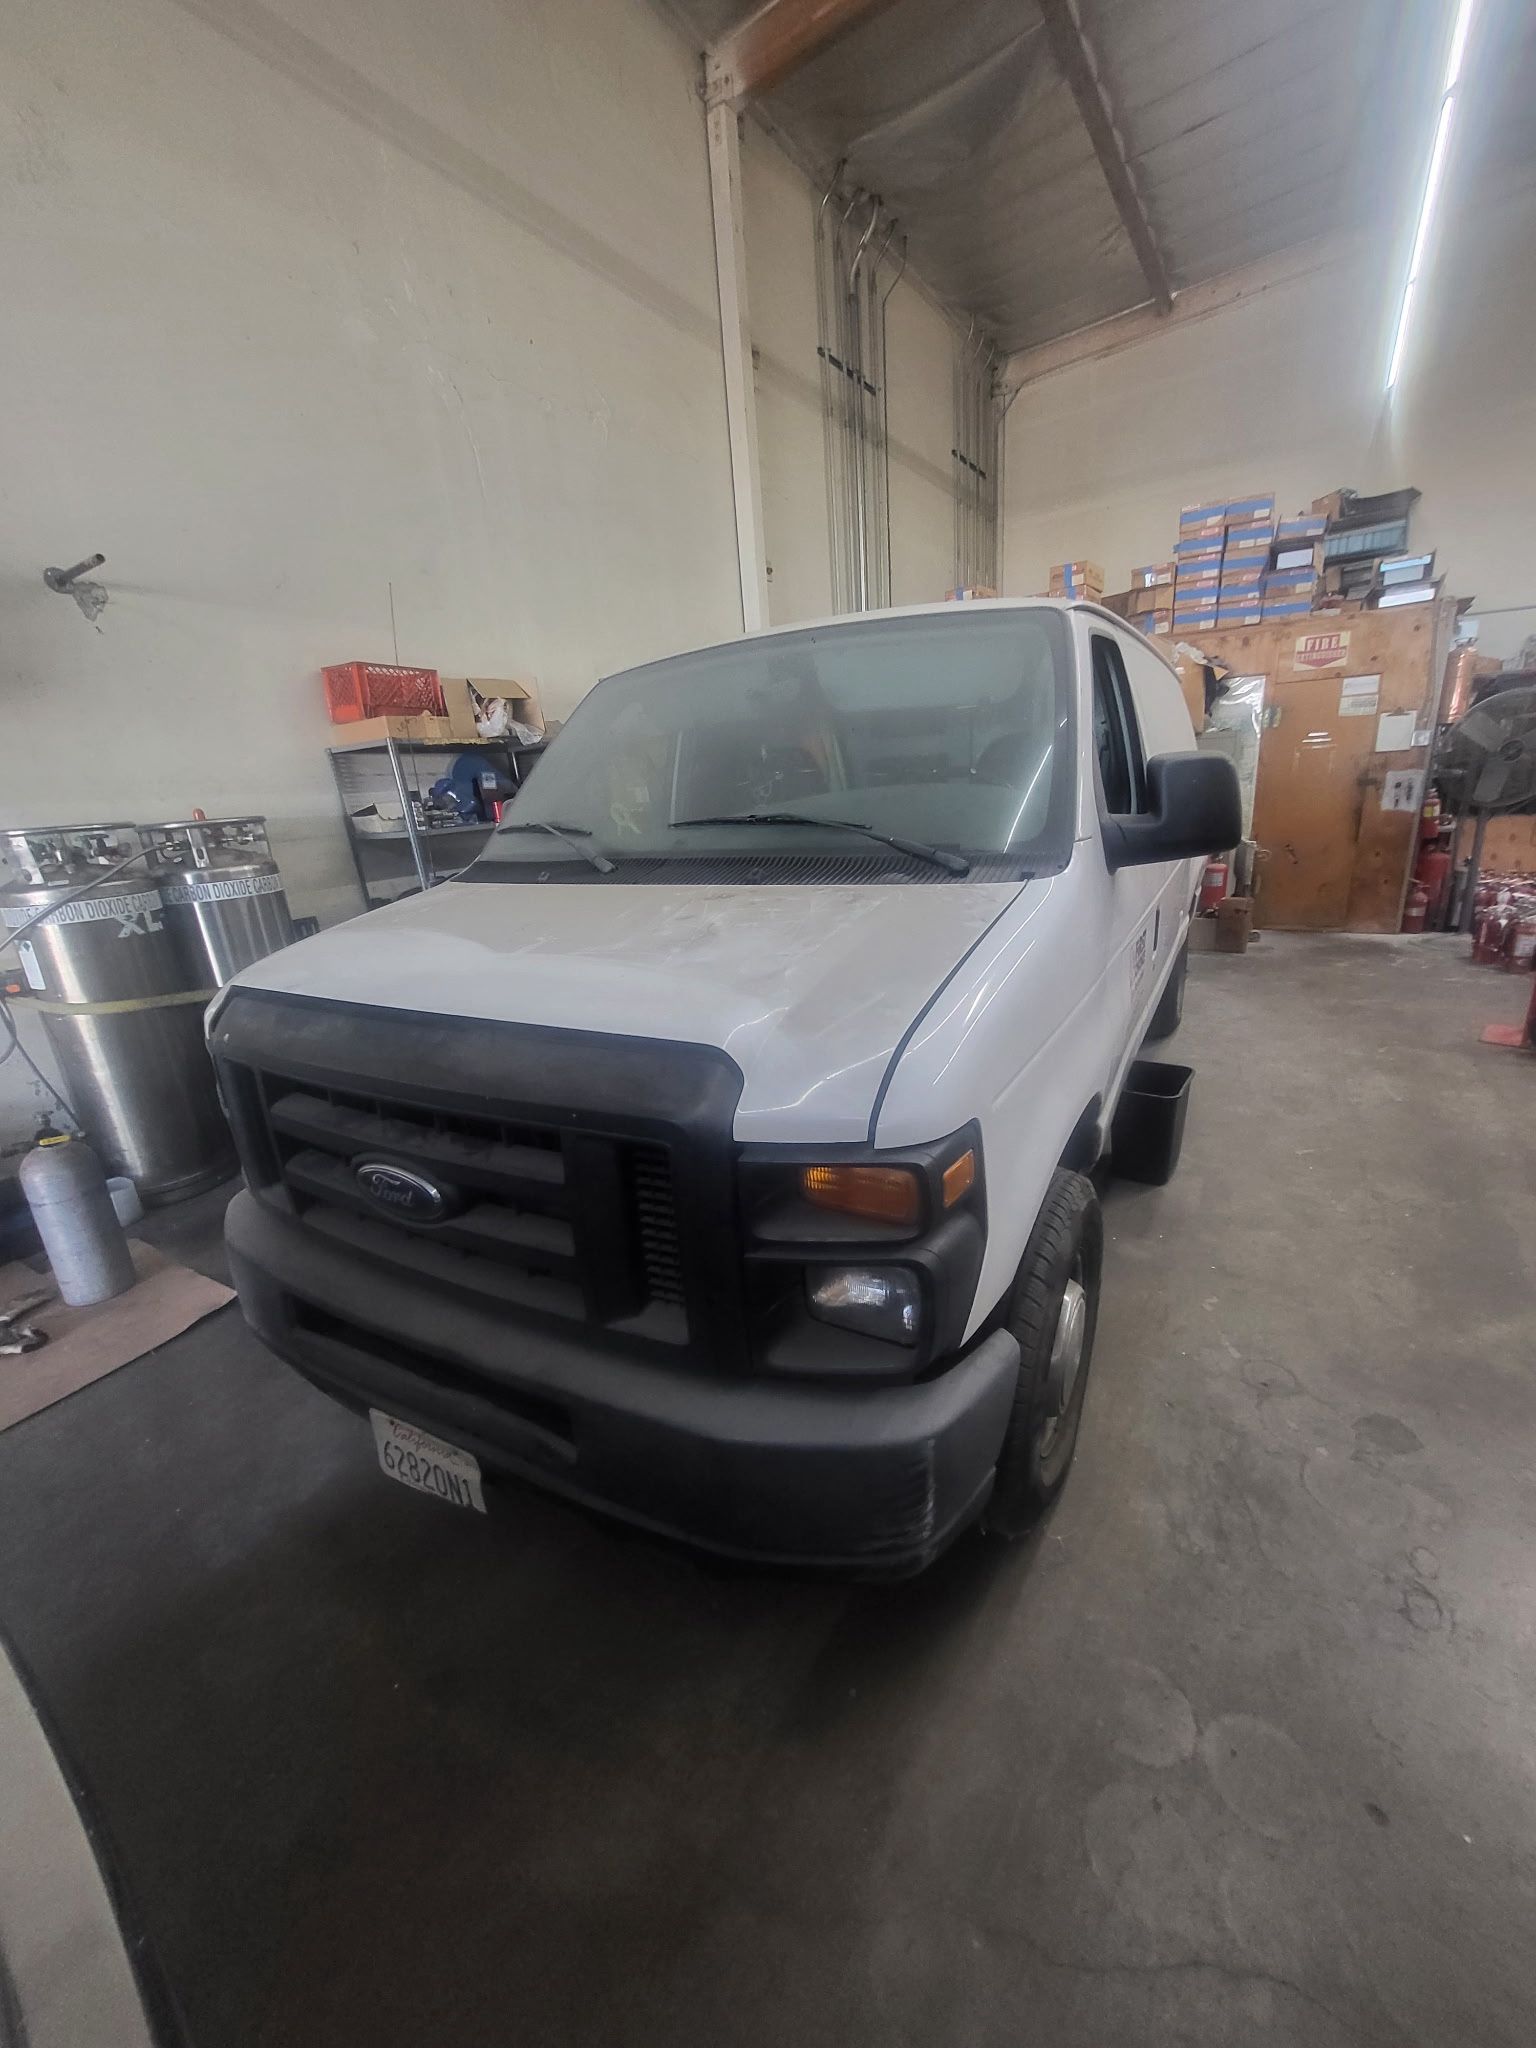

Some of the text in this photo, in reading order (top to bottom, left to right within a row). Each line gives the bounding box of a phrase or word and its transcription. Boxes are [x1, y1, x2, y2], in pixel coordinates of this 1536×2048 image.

[1306, 636, 1339, 651] FIRE
[213, 879, 252, 898] DIOXIDE
[85, 896, 130, 919] DIOXIDE
[113, 911, 163, 938] XL
[371, 1173, 413, 1206] Ford
